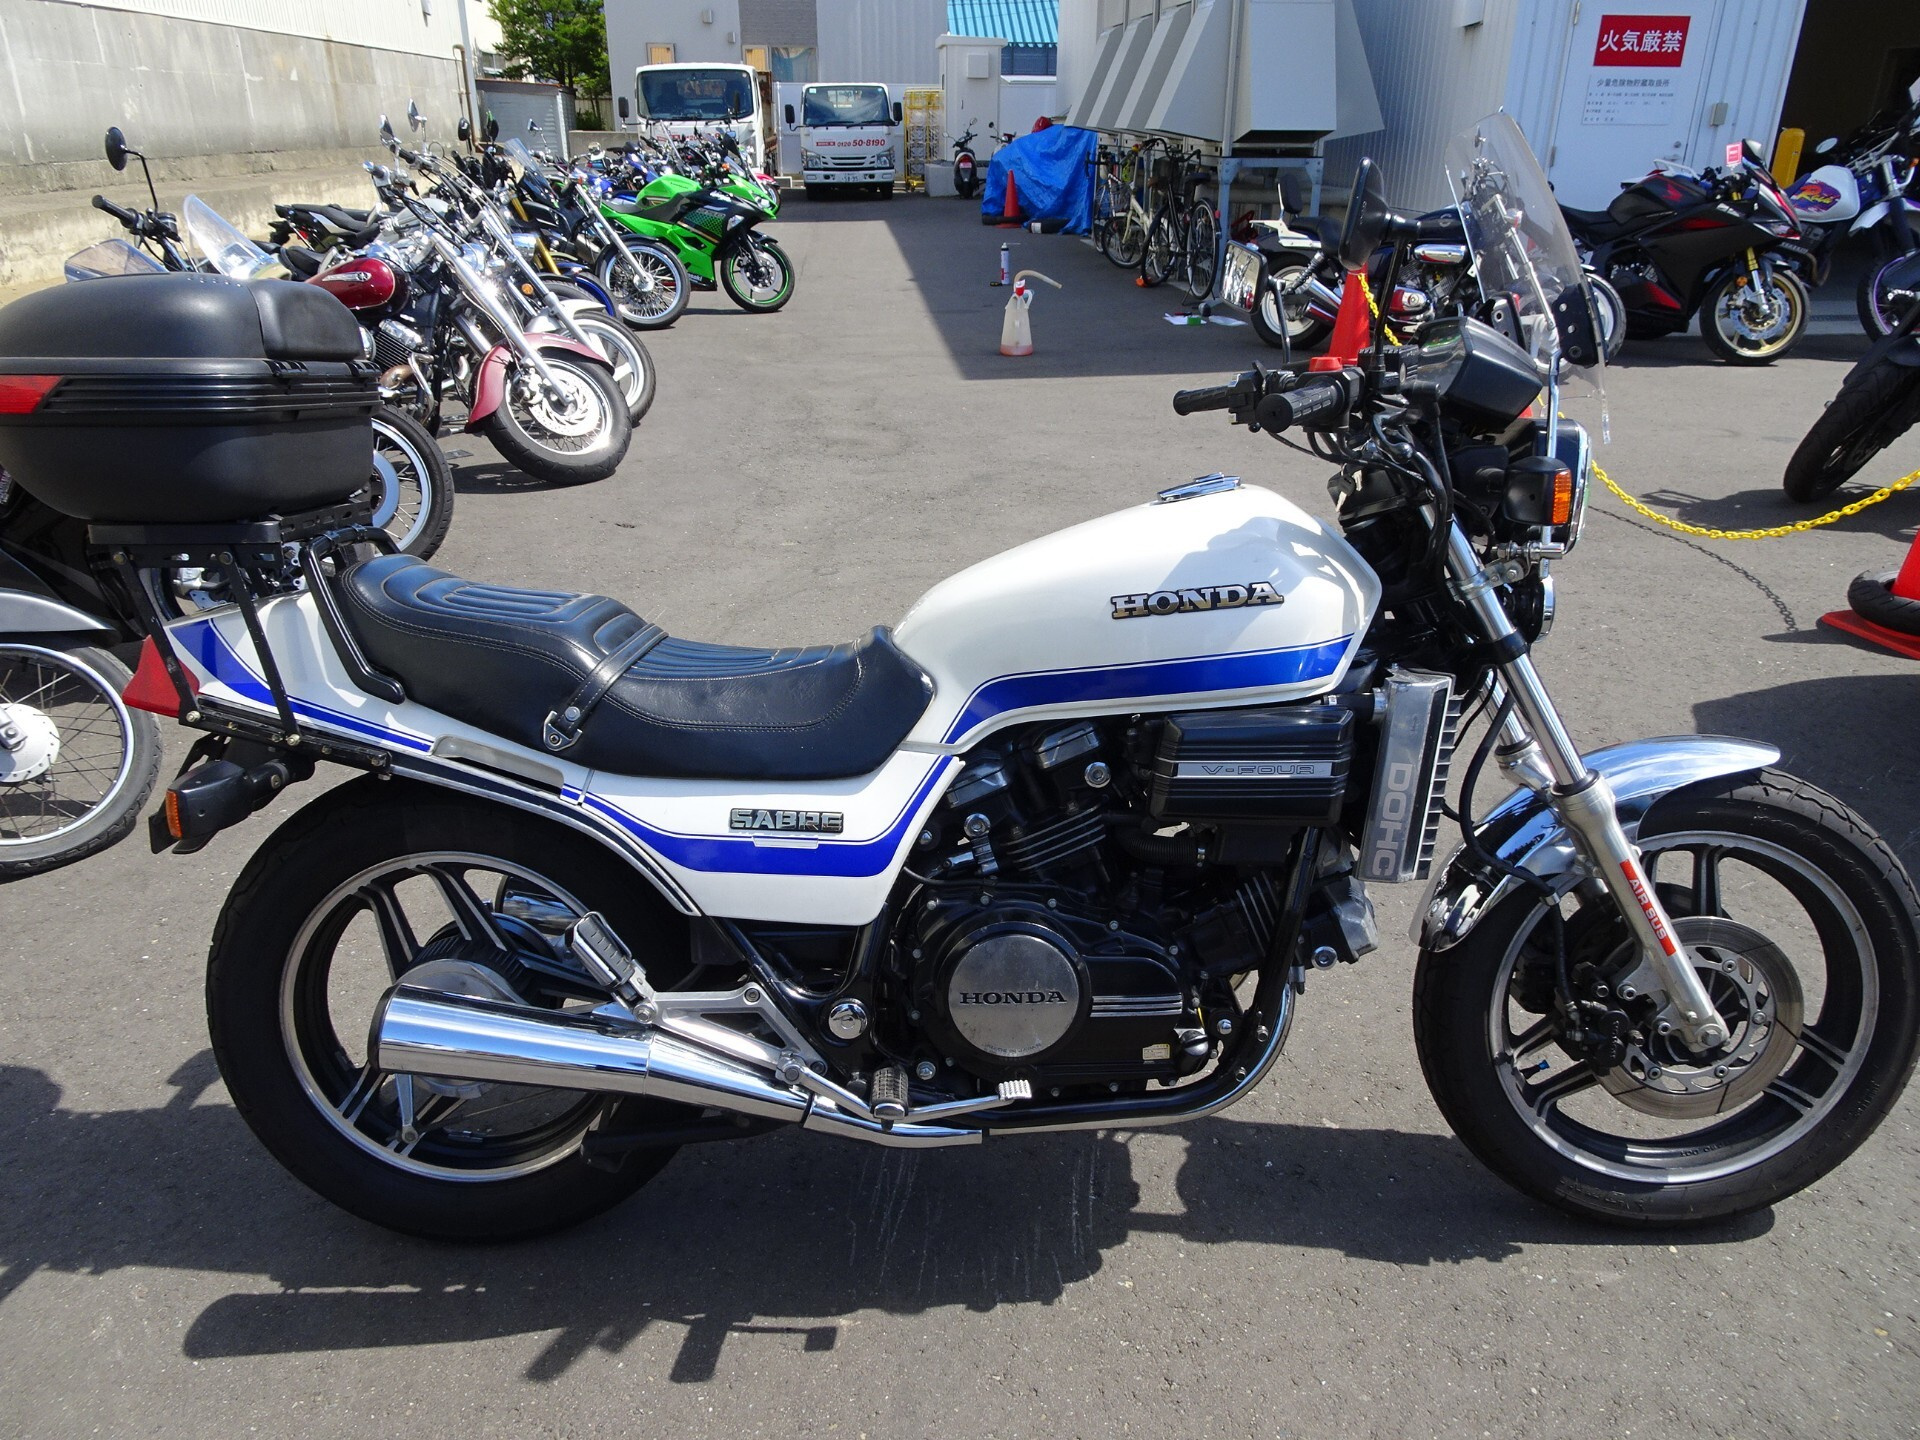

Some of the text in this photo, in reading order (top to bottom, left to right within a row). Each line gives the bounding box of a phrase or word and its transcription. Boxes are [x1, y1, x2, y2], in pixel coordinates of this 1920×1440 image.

[1600, 30, 1683, 52] 火気厳禁
[1111, 582, 1284, 618] HONDA
[1202, 765, 1315, 775] V-FOUR
[730, 809, 843, 832] SABRE
[1371, 762, 1413, 876] DOHC
[1630, 880, 1668, 940] AIR SUS
[960, 991, 1068, 1005] HONDA
